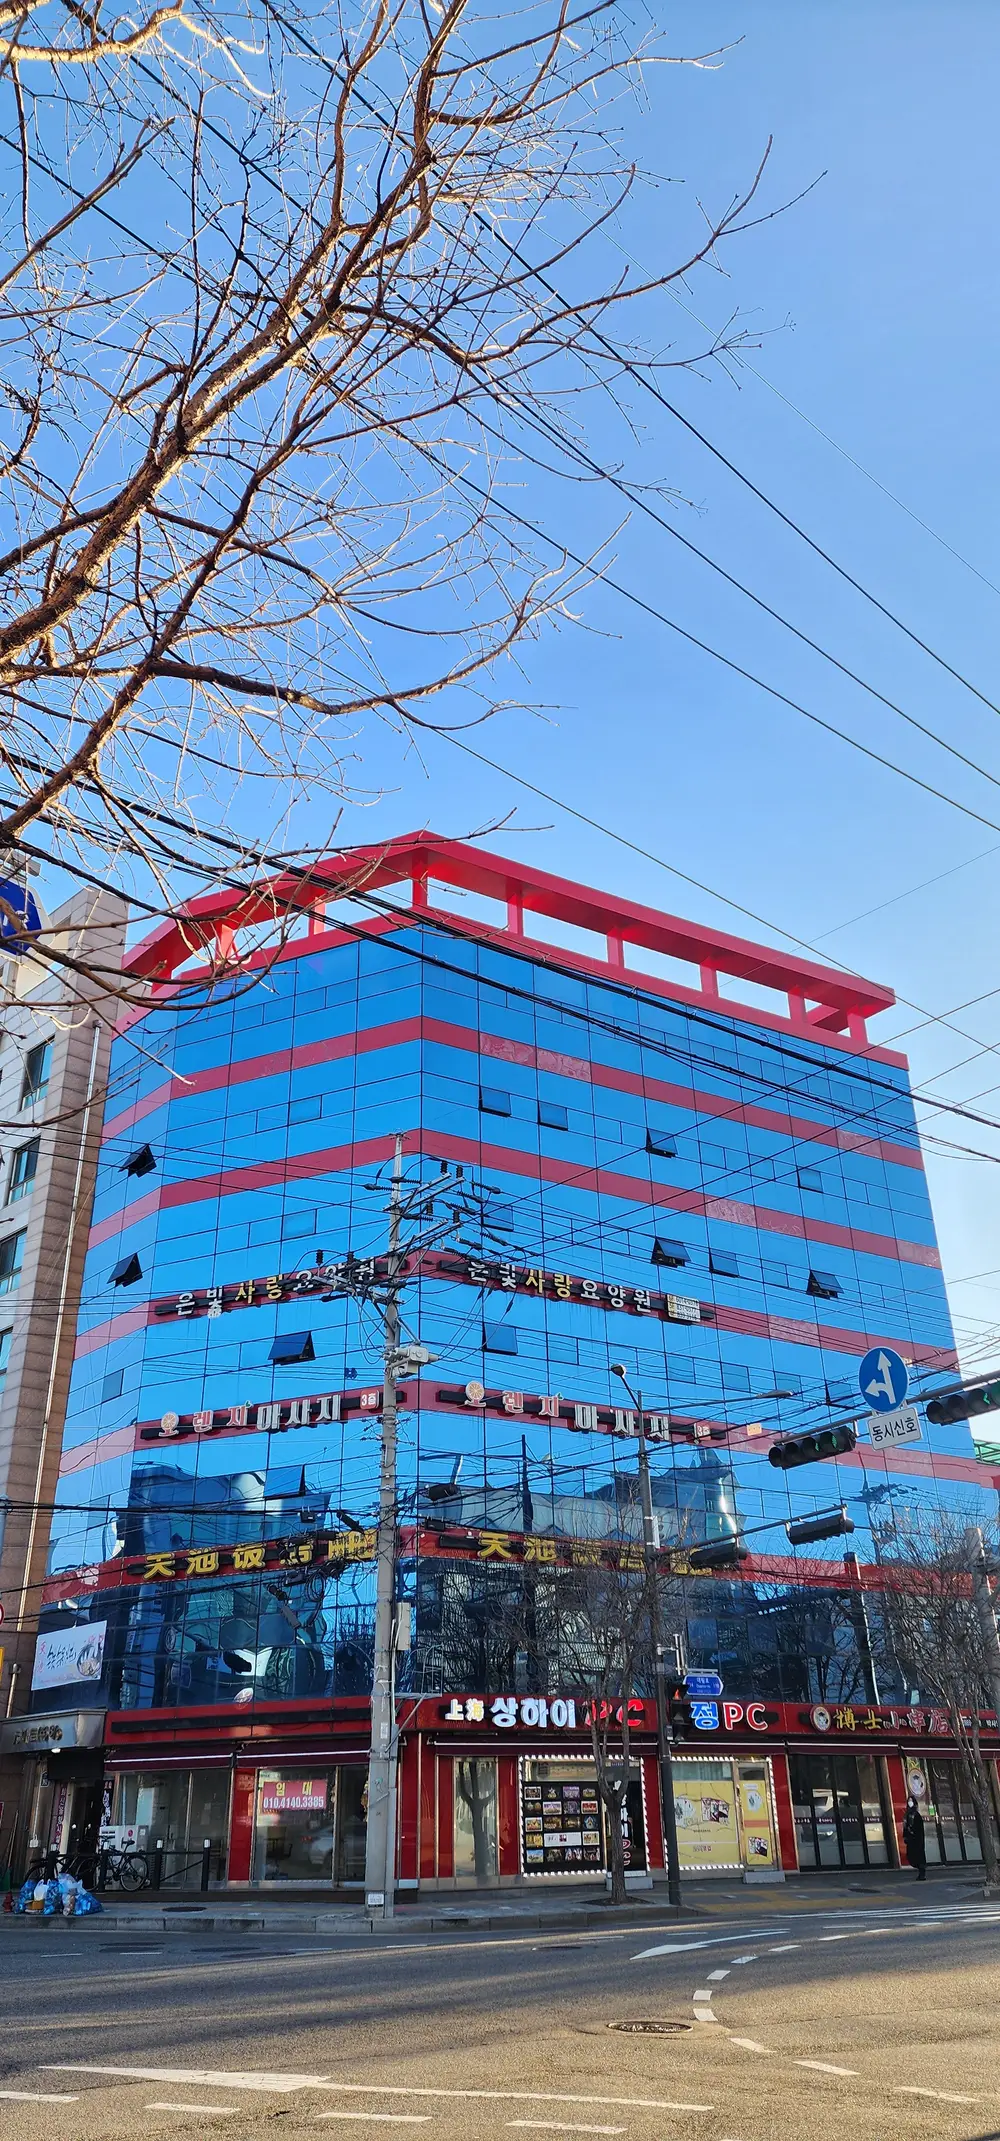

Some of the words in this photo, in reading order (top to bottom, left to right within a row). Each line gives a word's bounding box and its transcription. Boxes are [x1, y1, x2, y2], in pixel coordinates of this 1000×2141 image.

[467, 1261, 651, 1313] 은빛사랑요양원
[158, 1401, 253, 1437] 오렌지
[256, 1394, 342, 1431] 마사지
[465, 1380, 562, 1418] 오렌지
[574, 1404, 670, 1441] 마사지
[872, 1416, 918, 1442] 동시신호
[477, 1531, 647, 1571] 天池
[445, 1698, 485, 1723] 上海
[490, 1698, 577, 1729] 상하이
[263, 1795, 325, 1809] 010.4140.3385
